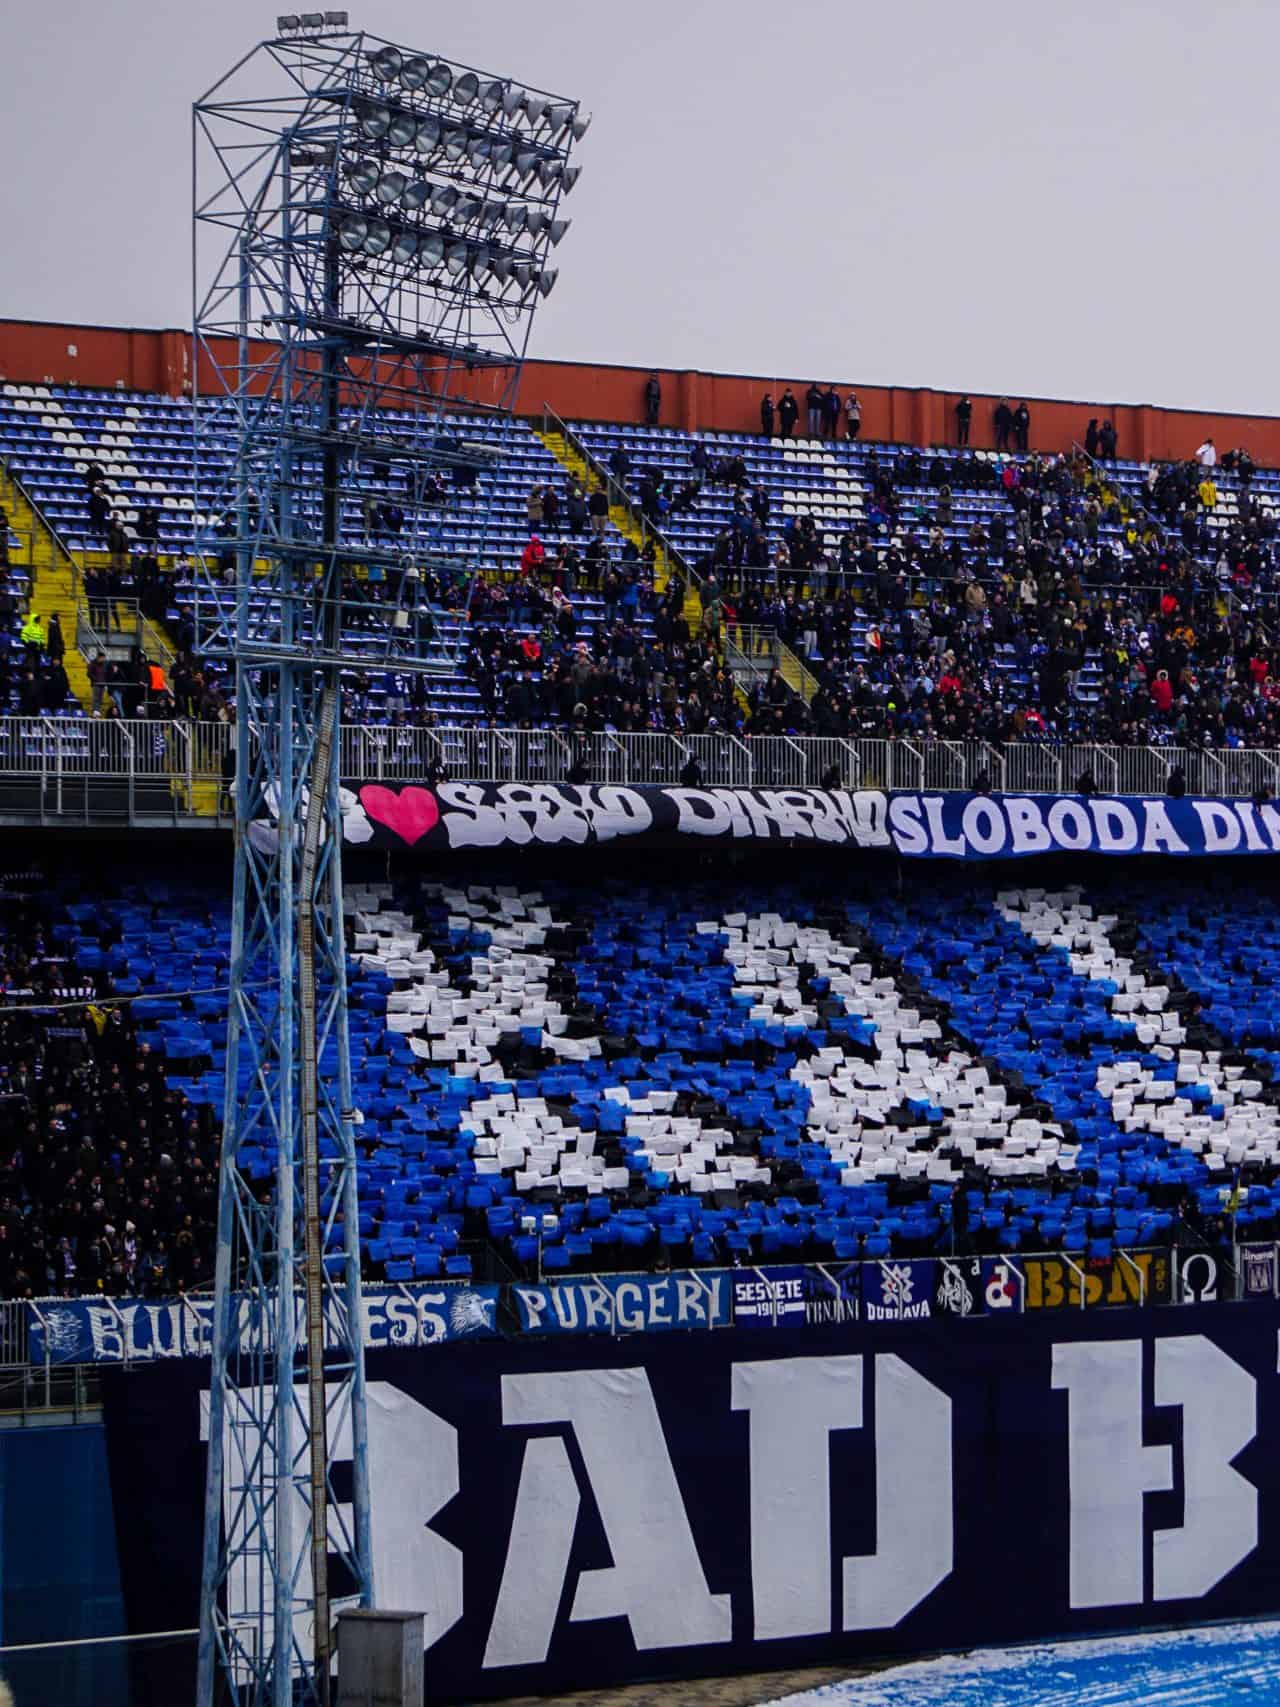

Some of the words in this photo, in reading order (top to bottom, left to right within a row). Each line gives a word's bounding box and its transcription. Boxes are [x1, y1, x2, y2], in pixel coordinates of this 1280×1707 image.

[892, 797, 1190, 856] SLOBODA
[519, 1278, 720, 1329] PURGERI
[735, 1280, 803, 1302] SESVETE
[85, 1300, 214, 1359] BLUE
[199, 1352, 953, 1671] BAD
